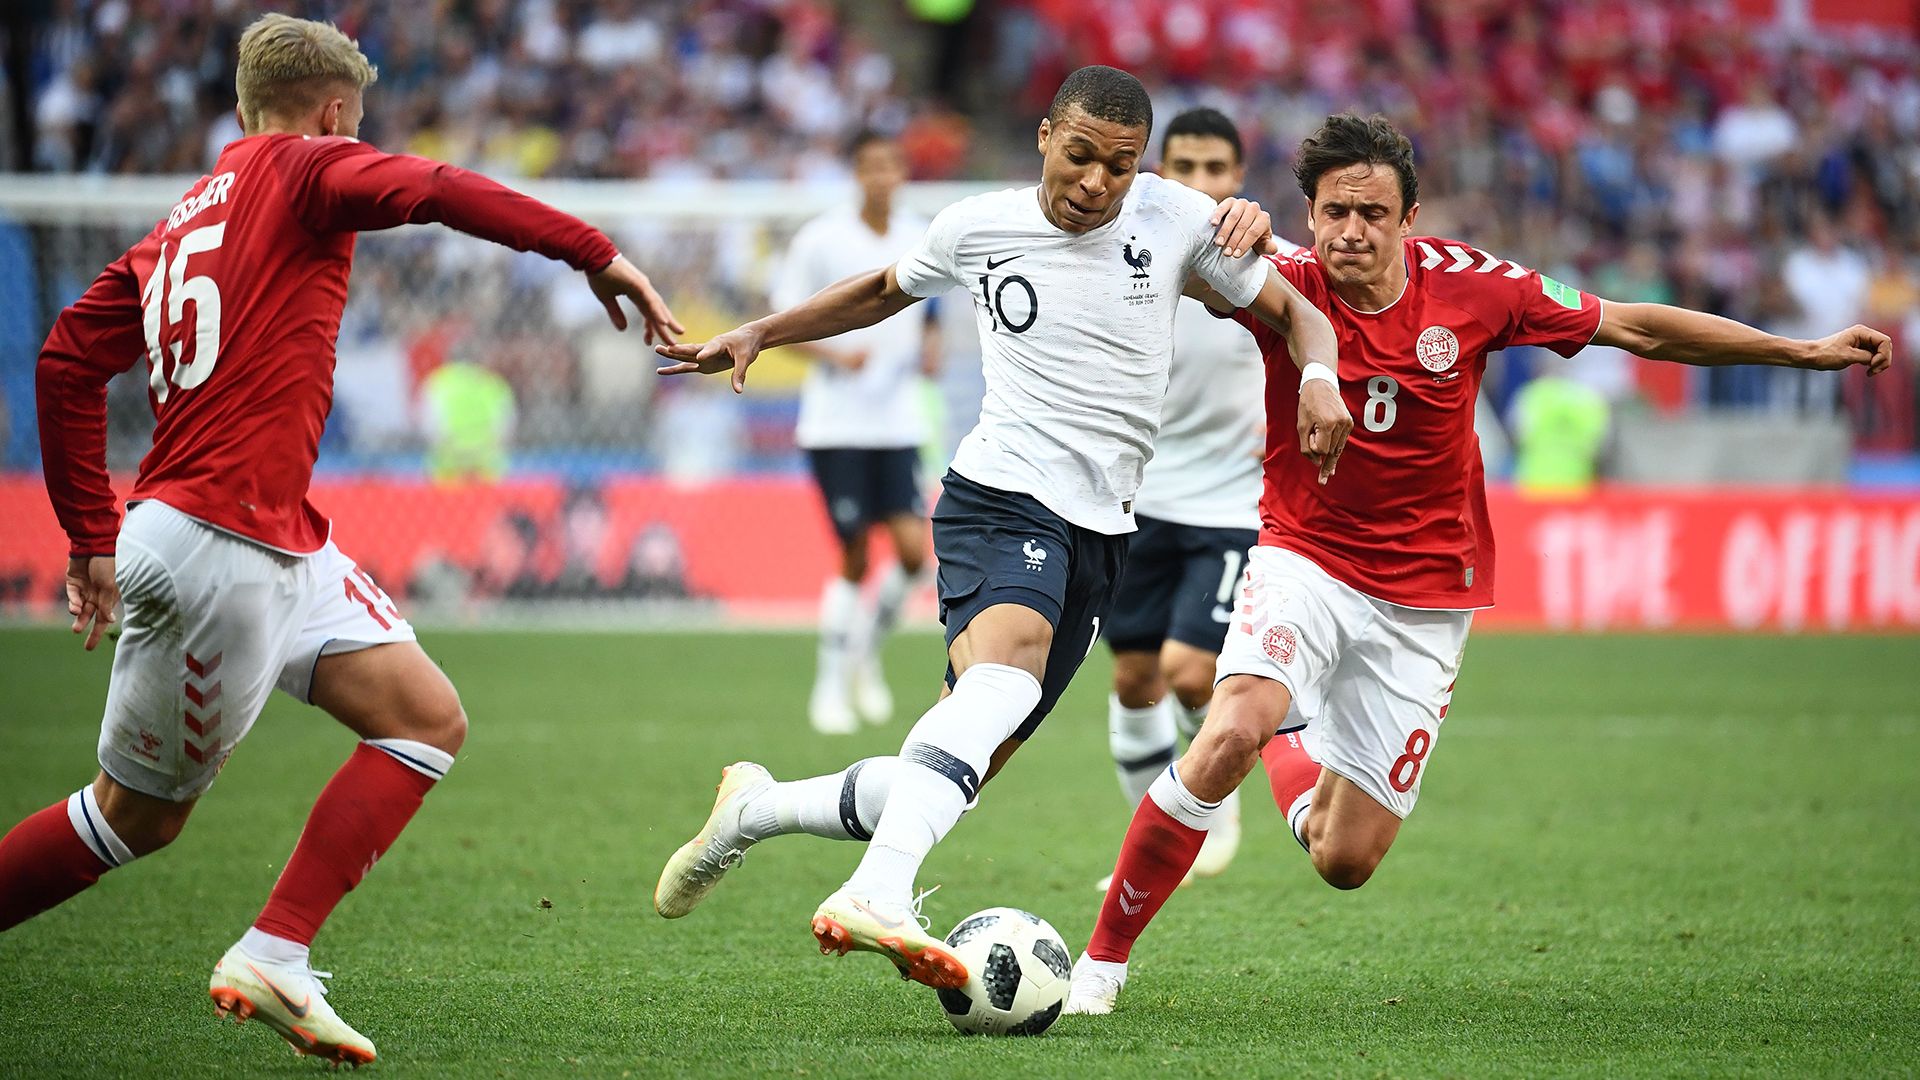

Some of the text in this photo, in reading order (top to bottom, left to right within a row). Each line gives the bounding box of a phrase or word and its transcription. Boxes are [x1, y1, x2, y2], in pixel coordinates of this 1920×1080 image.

[141, 221, 227, 403] 15
[979, 275, 1039, 334] 10
[1363, 375, 1399, 433] 8
[1388, 729, 1431, 793] 8
